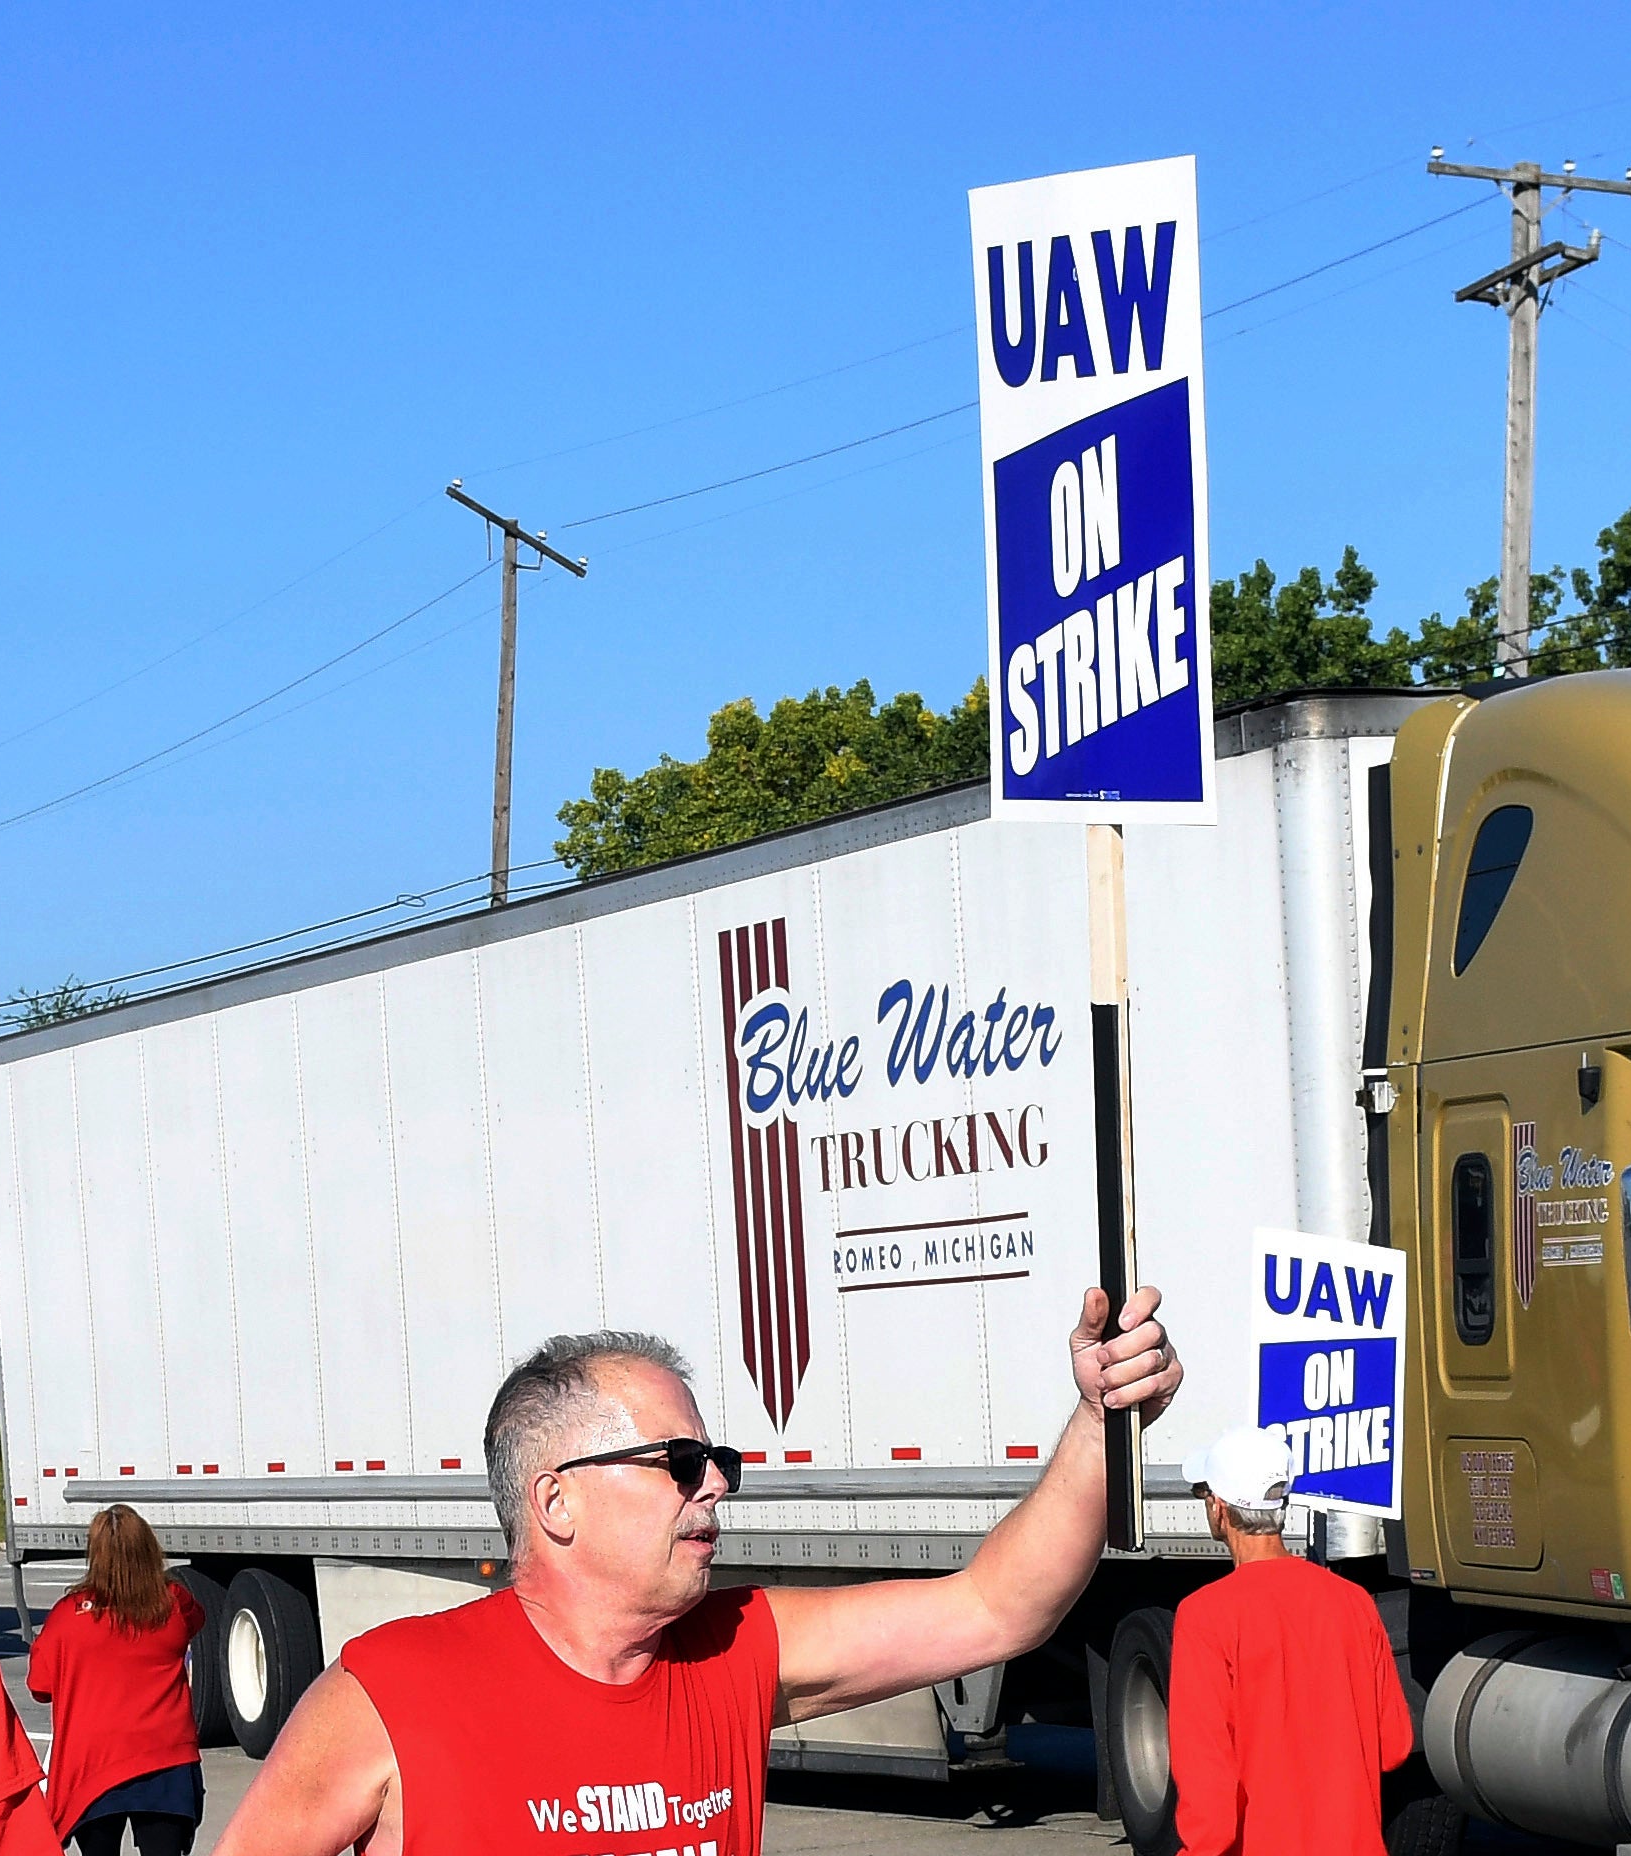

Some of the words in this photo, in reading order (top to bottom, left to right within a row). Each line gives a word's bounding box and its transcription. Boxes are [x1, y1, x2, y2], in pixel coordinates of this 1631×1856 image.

[986, 219, 1177, 389] UAW
[1049, 433, 1121, 599] ON
[1007, 554, 1190, 777] STRIKE
[740, 1001, 864, 1114] Blue
[876, 978, 1063, 1088] Water
[810, 1103, 1050, 1193] TRUCKING
[1517, 1144, 1554, 1193] Blue
[1558, 1145, 1615, 1190] Water
[924, 1229, 1035, 1267] MICHIGAN
[1536, 1197, 1610, 1227] TRUCKING
[1264, 1253, 1394, 1330] UAW
[1303, 1348, 1355, 1411] ON
[526, 1798, 577, 1833] We
[575, 1781, 668, 1833] STAND
[667, 1786, 733, 1830] Togethe
